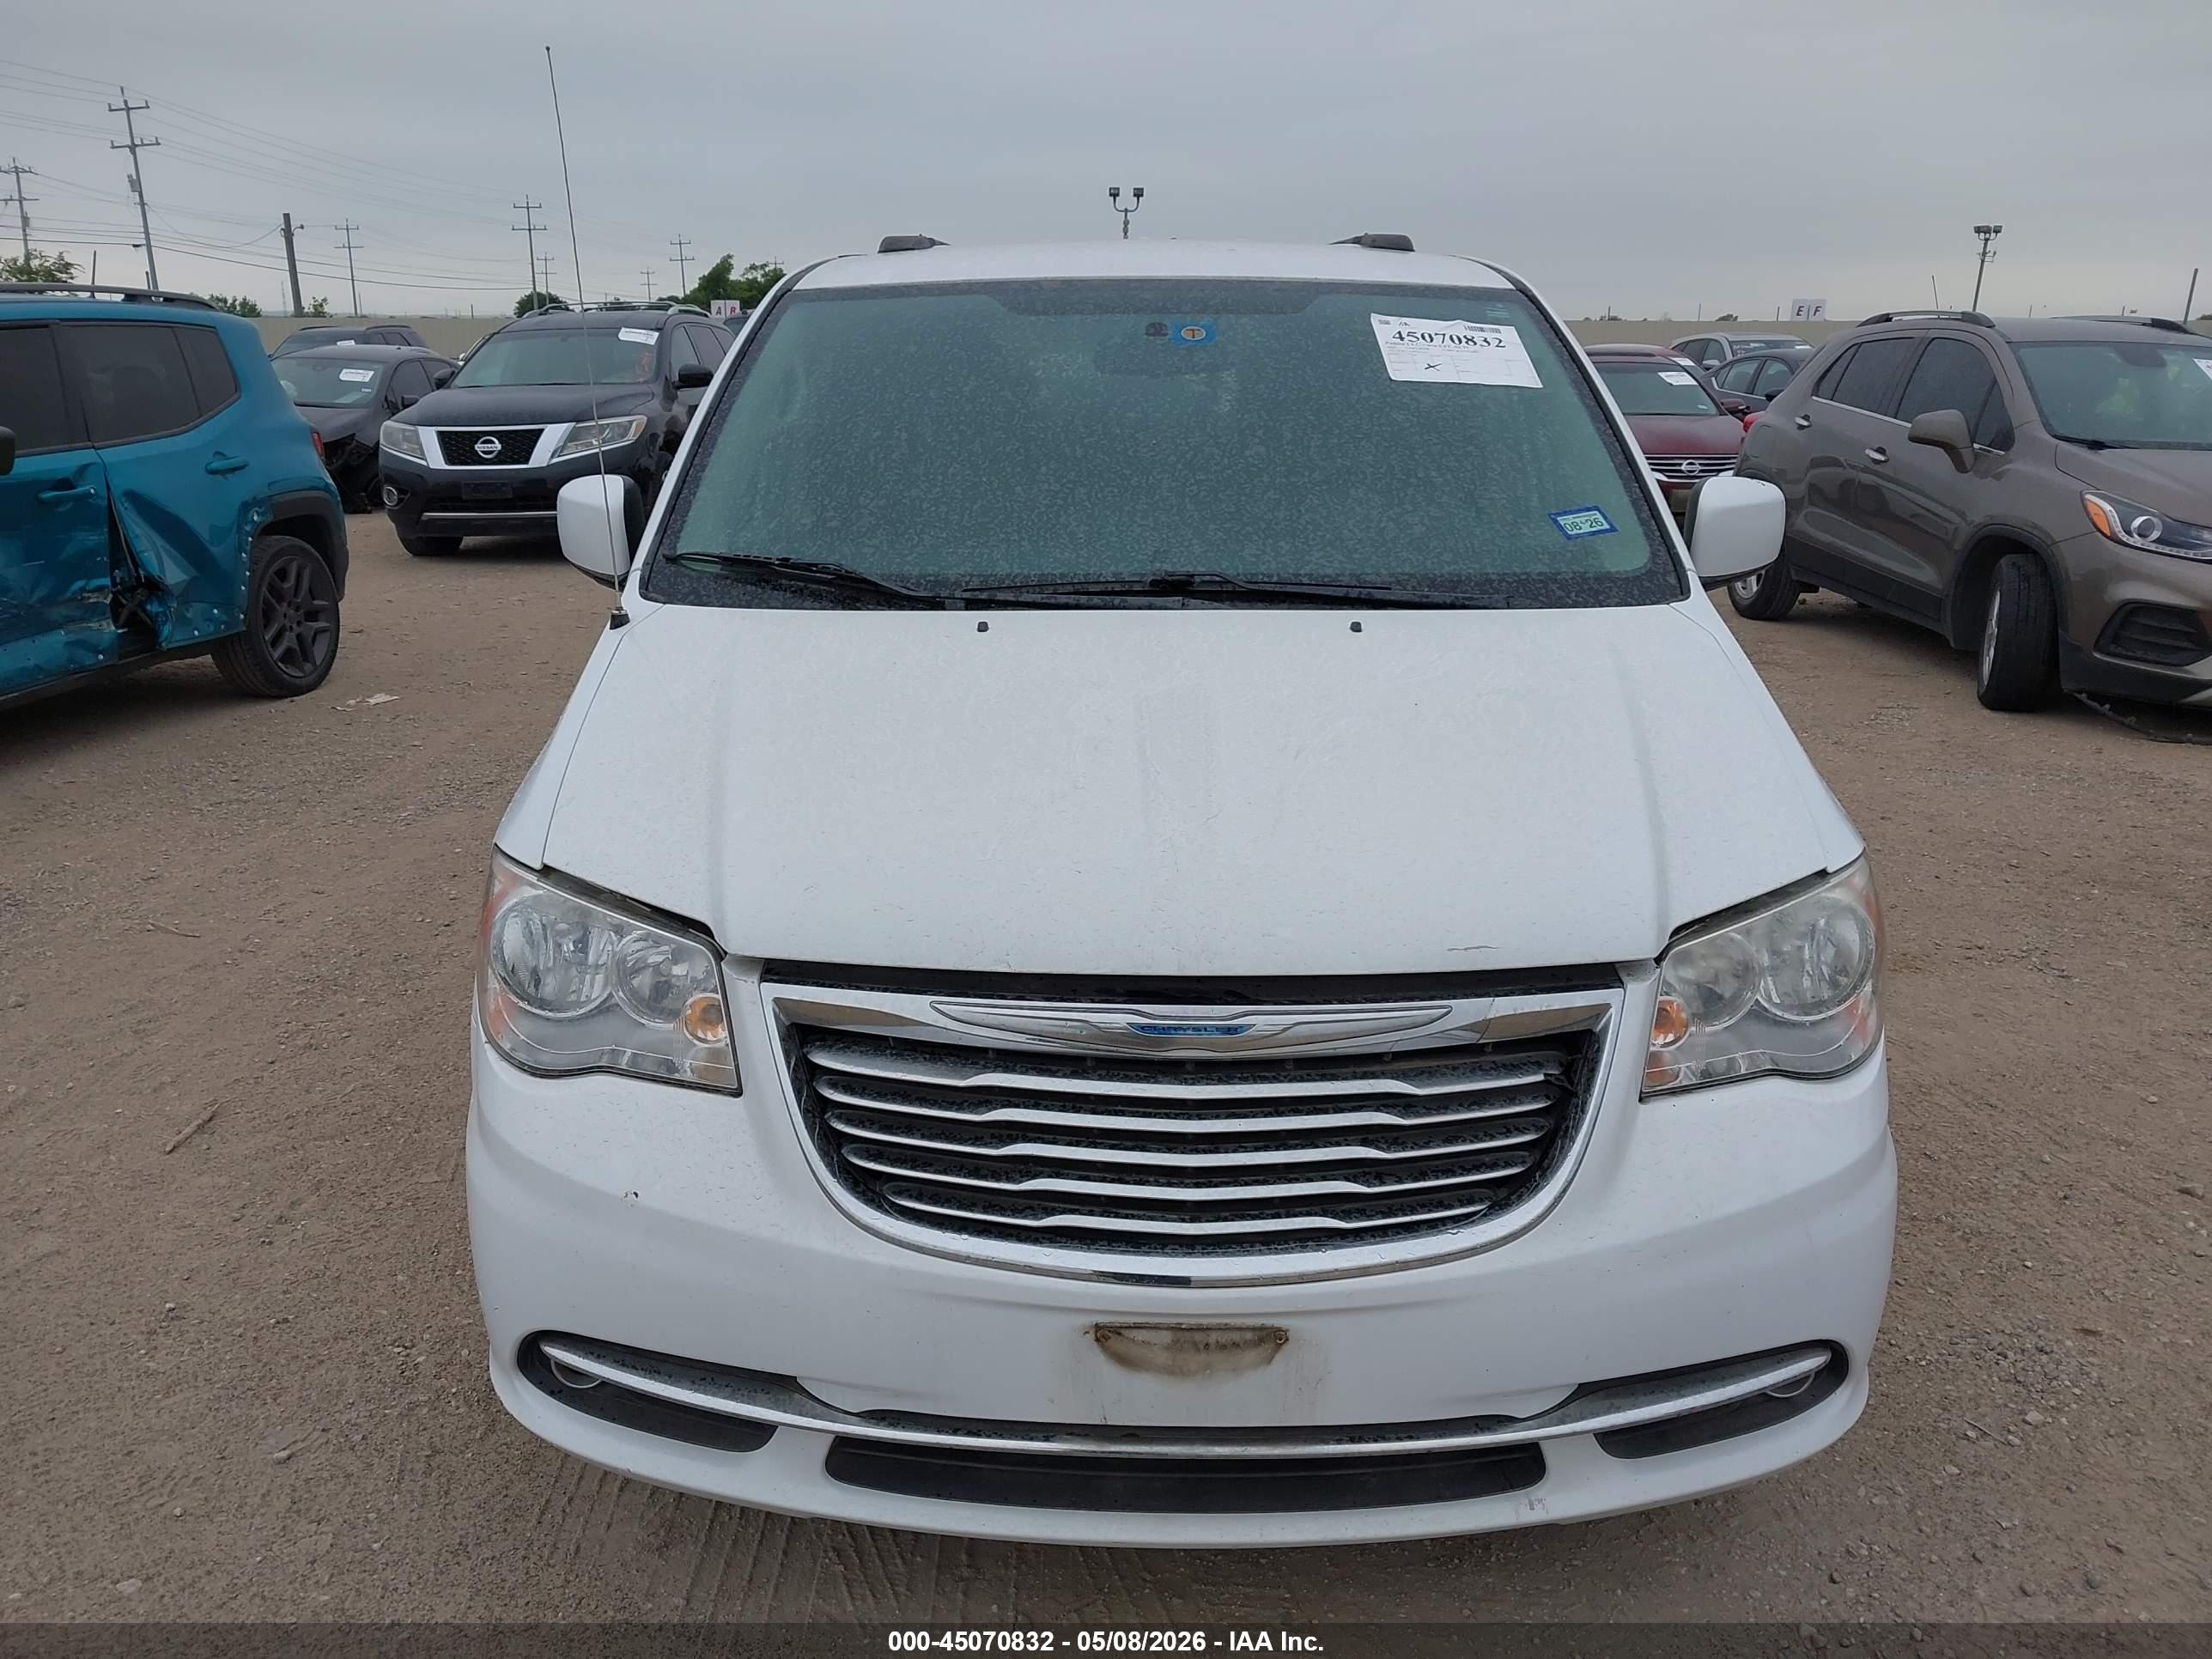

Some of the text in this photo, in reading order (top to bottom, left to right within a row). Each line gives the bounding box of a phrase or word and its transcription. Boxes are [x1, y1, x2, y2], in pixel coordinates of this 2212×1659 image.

[715, 306, 722, 316] A
[1796, 306, 1805, 317] E
[1813, 306, 1823, 317] F
[1392, 330, 1506, 349] 45070832
[1139, 1024, 1239, 1033] CHRYSLER
